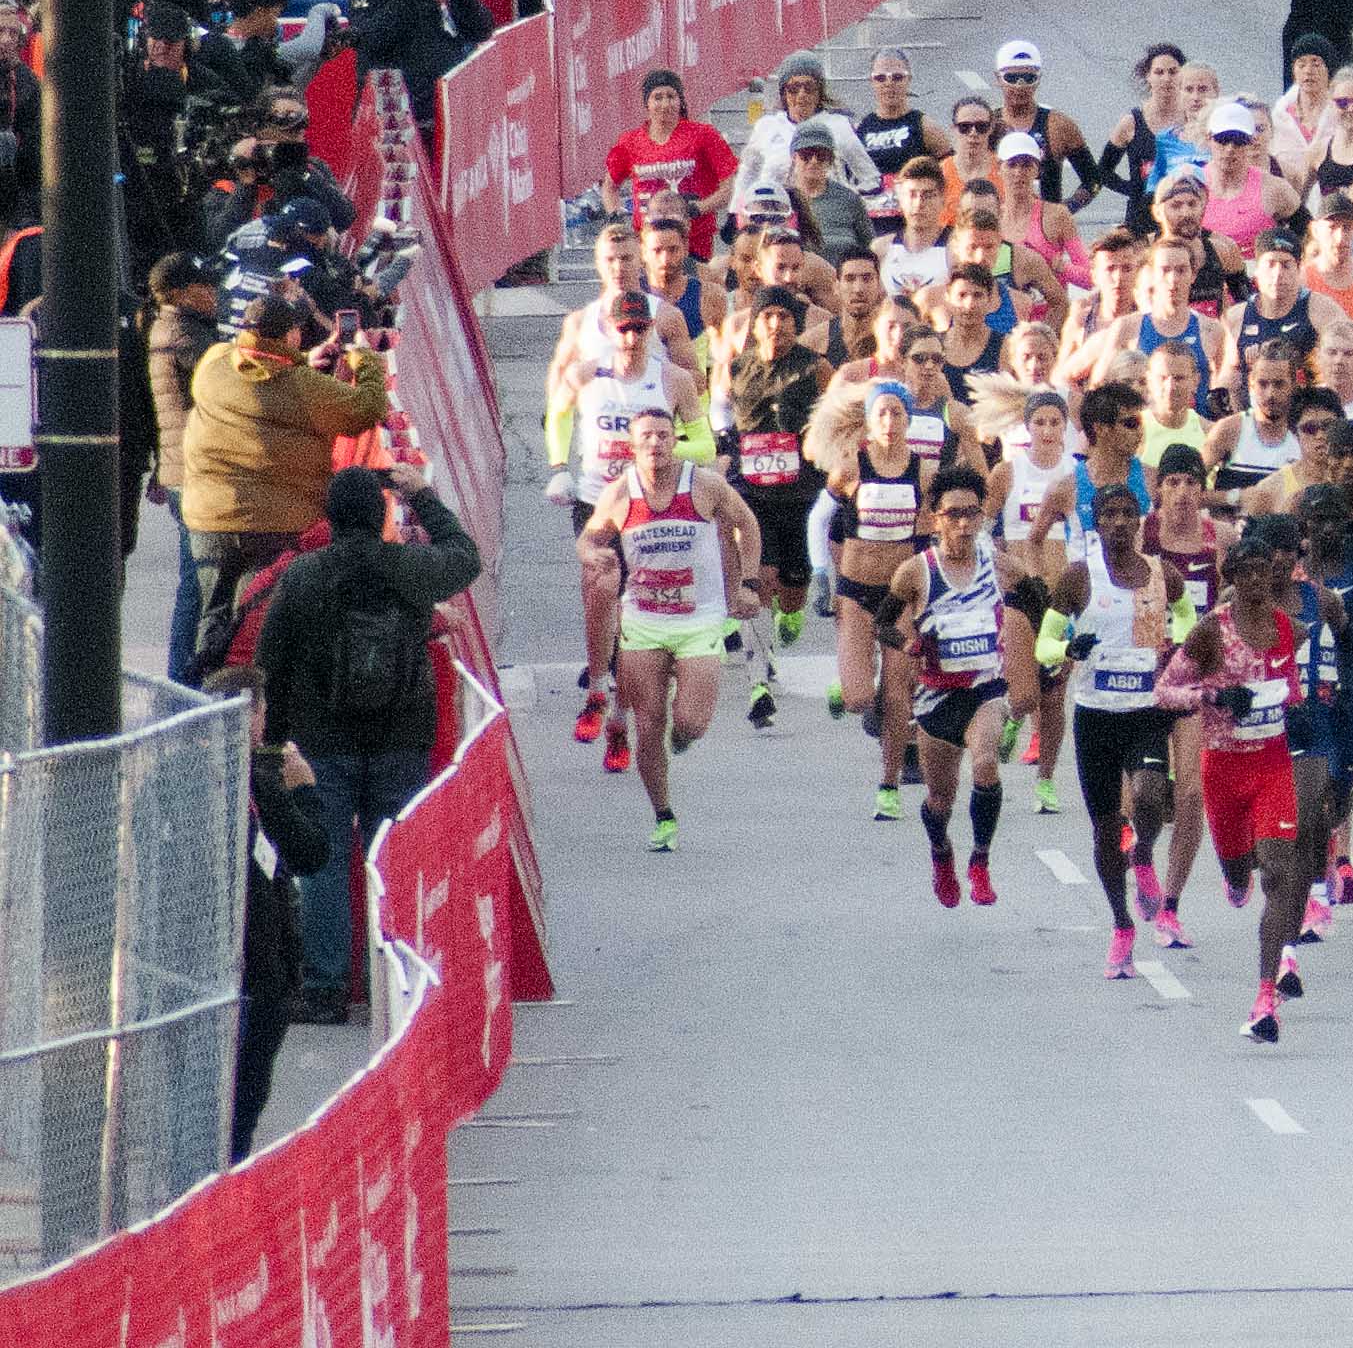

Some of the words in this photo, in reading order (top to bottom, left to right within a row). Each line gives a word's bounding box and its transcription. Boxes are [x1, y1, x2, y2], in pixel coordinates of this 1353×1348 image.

[595, 414, 631, 432] GR
[753, 454, 788, 473] 676
[631, 524, 698, 544] GATESHEAD
[1107, 674, 1143, 690] ABDI
